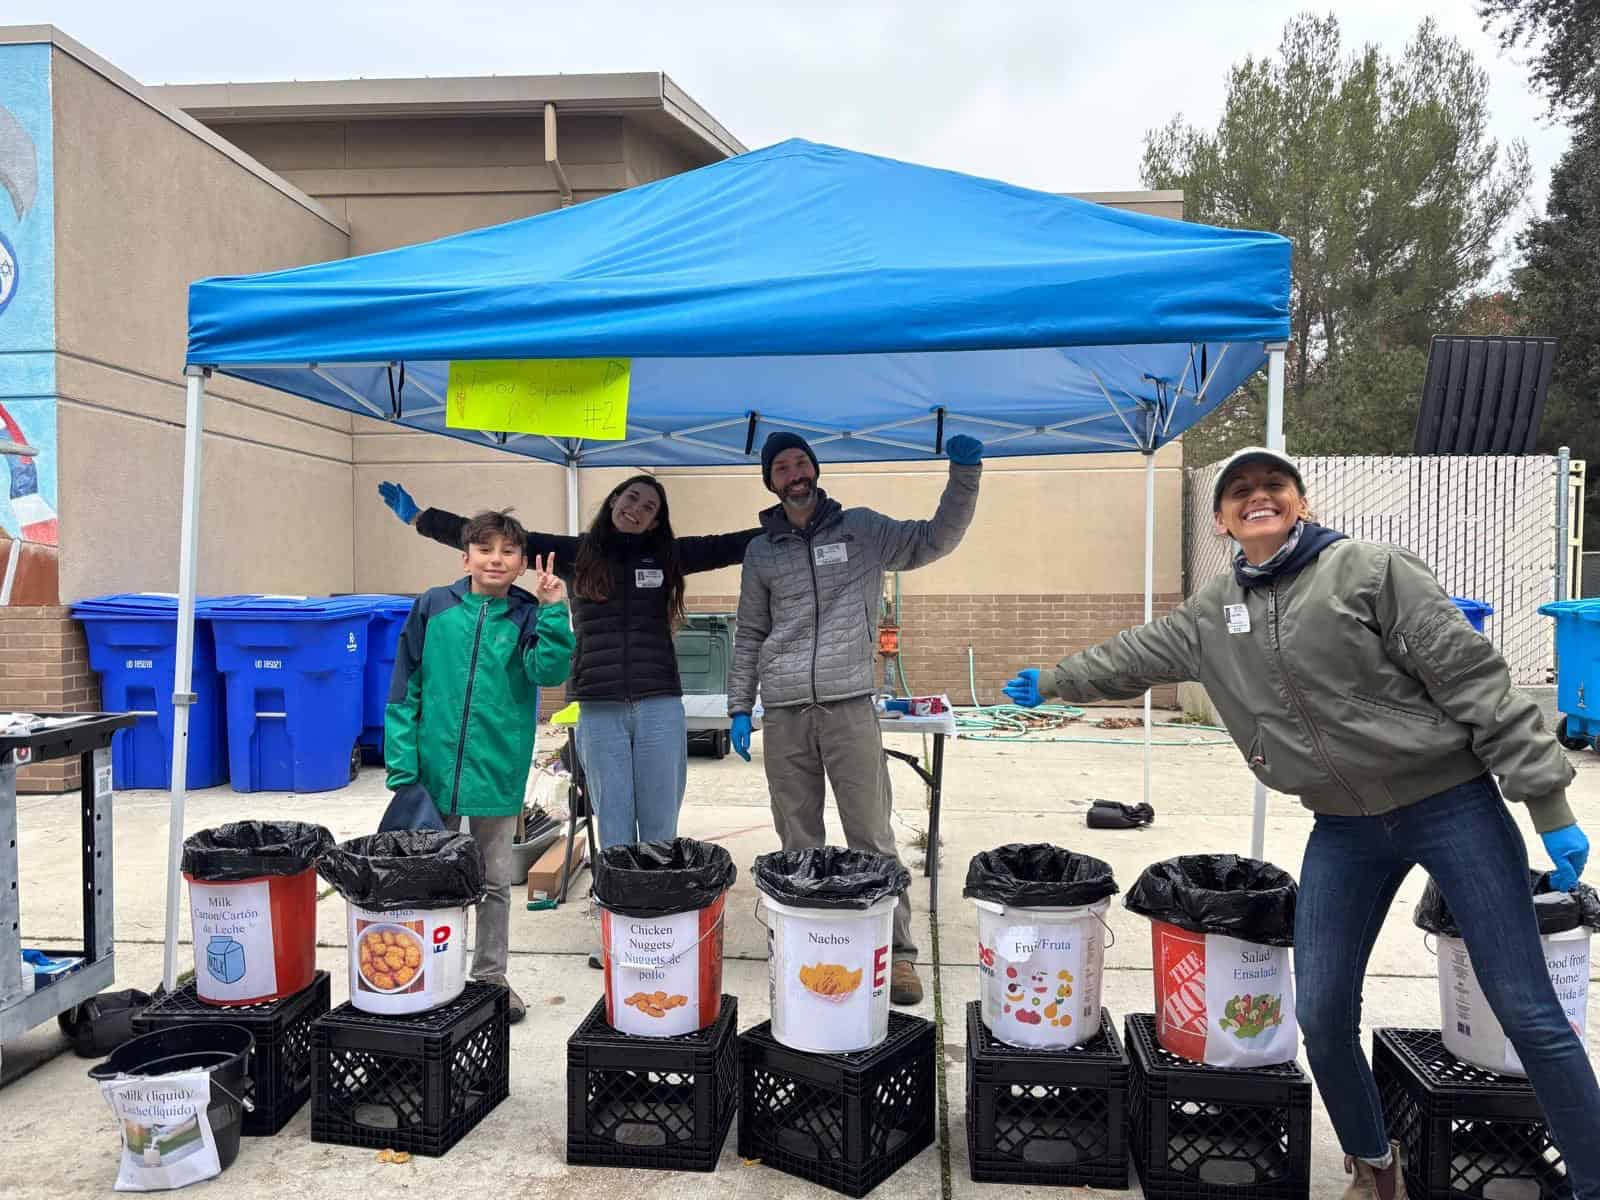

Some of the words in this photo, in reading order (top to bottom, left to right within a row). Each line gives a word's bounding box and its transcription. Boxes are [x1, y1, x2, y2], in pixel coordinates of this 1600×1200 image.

[208, 897, 232, 907] Milk
[216, 924, 245, 933] Leche
[630, 923, 673, 935] Chicken
[808, 932, 850, 945] Nachos
[1169, 950, 1204, 984] THE
[1548, 955, 1567, 969] ood
[639, 970, 665, 981] pollo
[1551, 974, 1579, 985] Home
[118, 1089, 143, 1102] Milk
